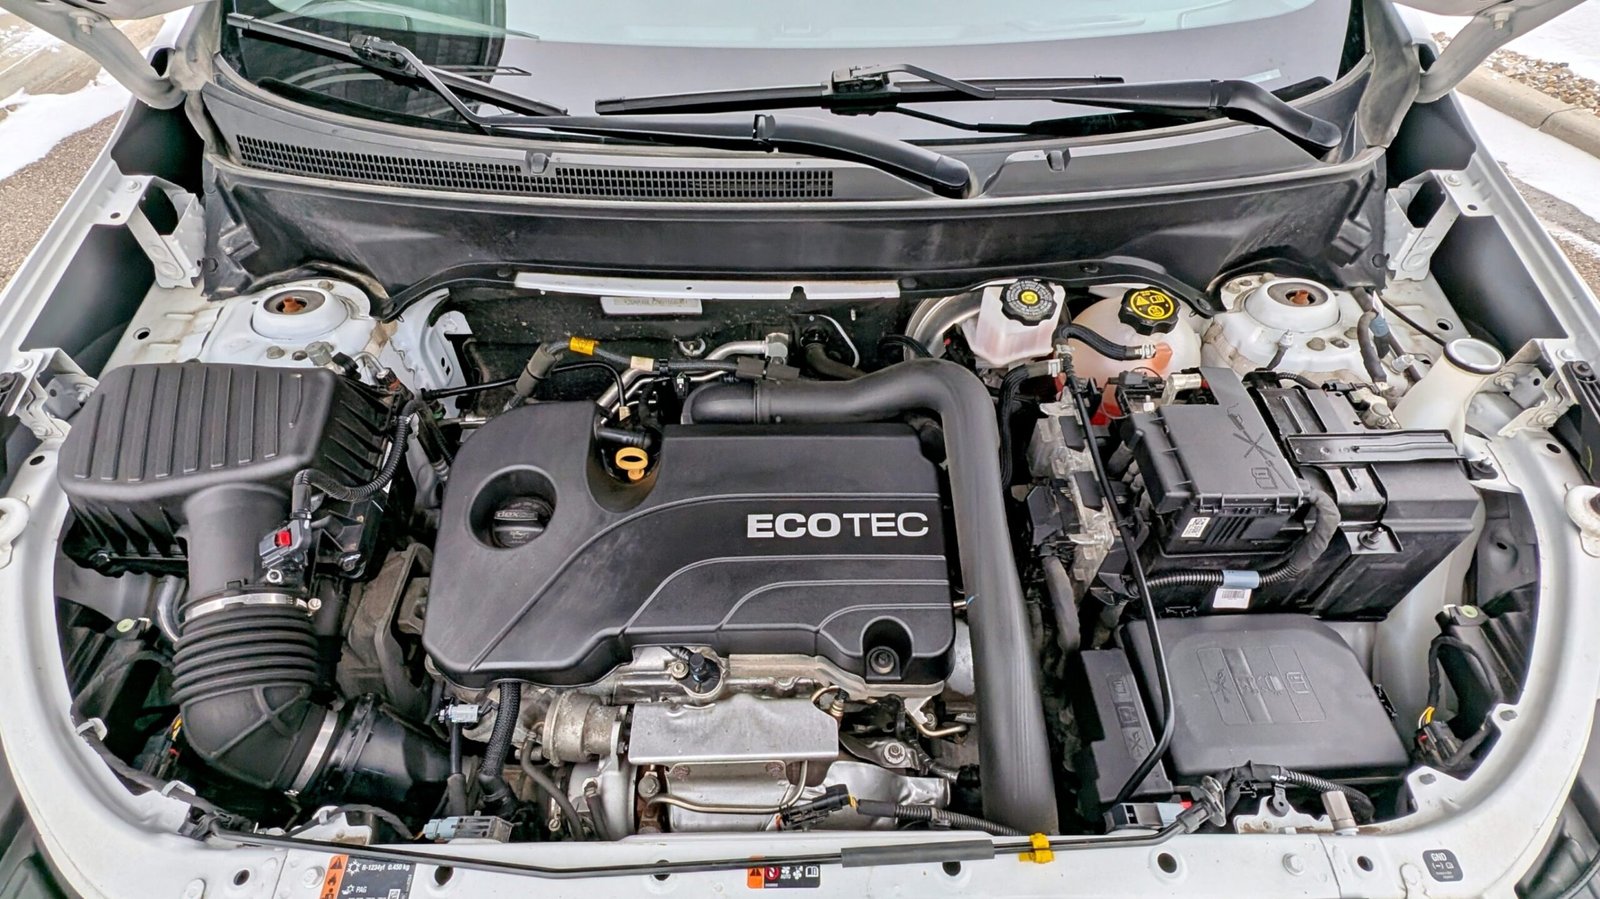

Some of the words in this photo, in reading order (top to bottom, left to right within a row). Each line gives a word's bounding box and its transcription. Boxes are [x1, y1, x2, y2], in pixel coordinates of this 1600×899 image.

[747, 512, 929, 538] ECOTEC
[1431, 852, 1447, 862] GND
[361, 864, 386, 872] R-1234yf
